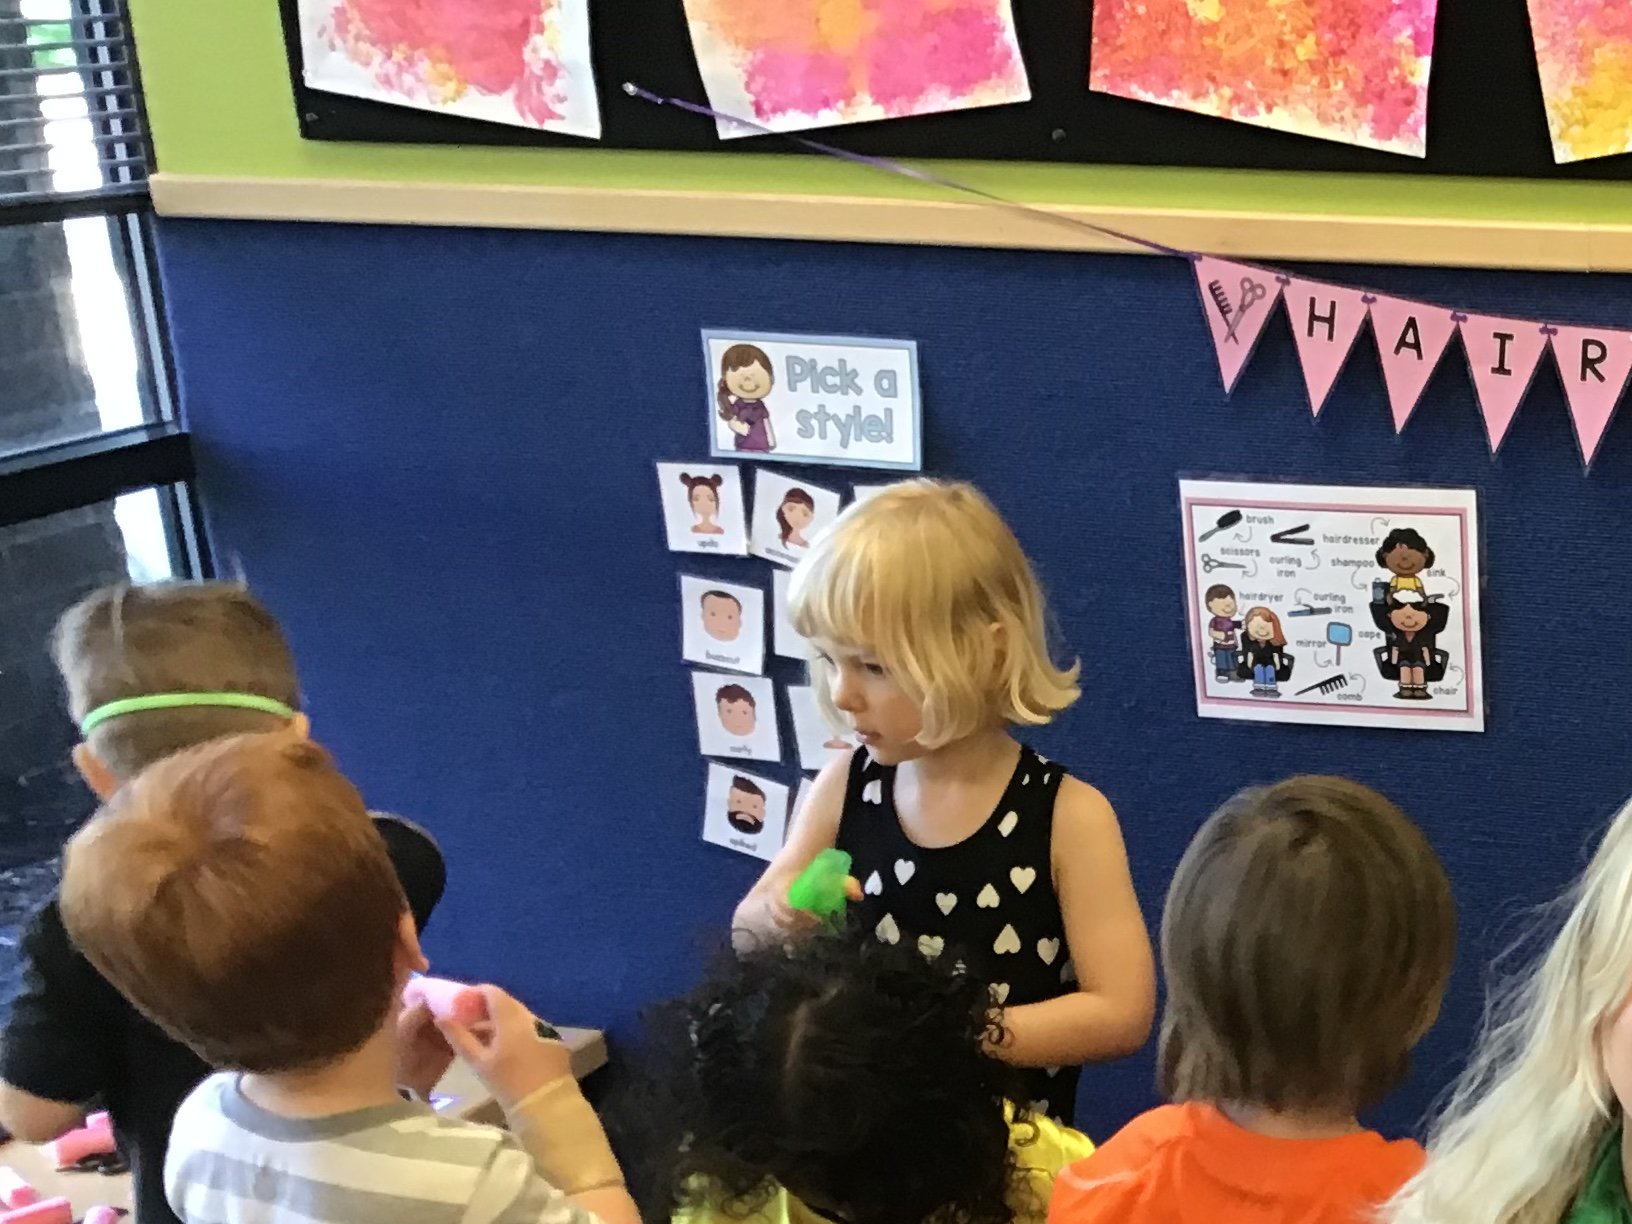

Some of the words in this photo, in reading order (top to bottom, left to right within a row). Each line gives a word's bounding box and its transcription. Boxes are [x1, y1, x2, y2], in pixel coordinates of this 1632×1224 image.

[1306, 296, 1608, 384] HAIR
[785, 355, 863, 397] Pick
[874, 369, 898, 398] a
[795, 403, 894, 449] style!
[1246, 514, 1275, 525] brush
[1322, 533, 1380, 545] hairdresser
[1219, 546, 1261, 558] scissors
[1330, 557, 1375, 569] shampoo
[1239, 591, 1284, 604] hairdryer
[1295, 639, 1328, 649] mirror
